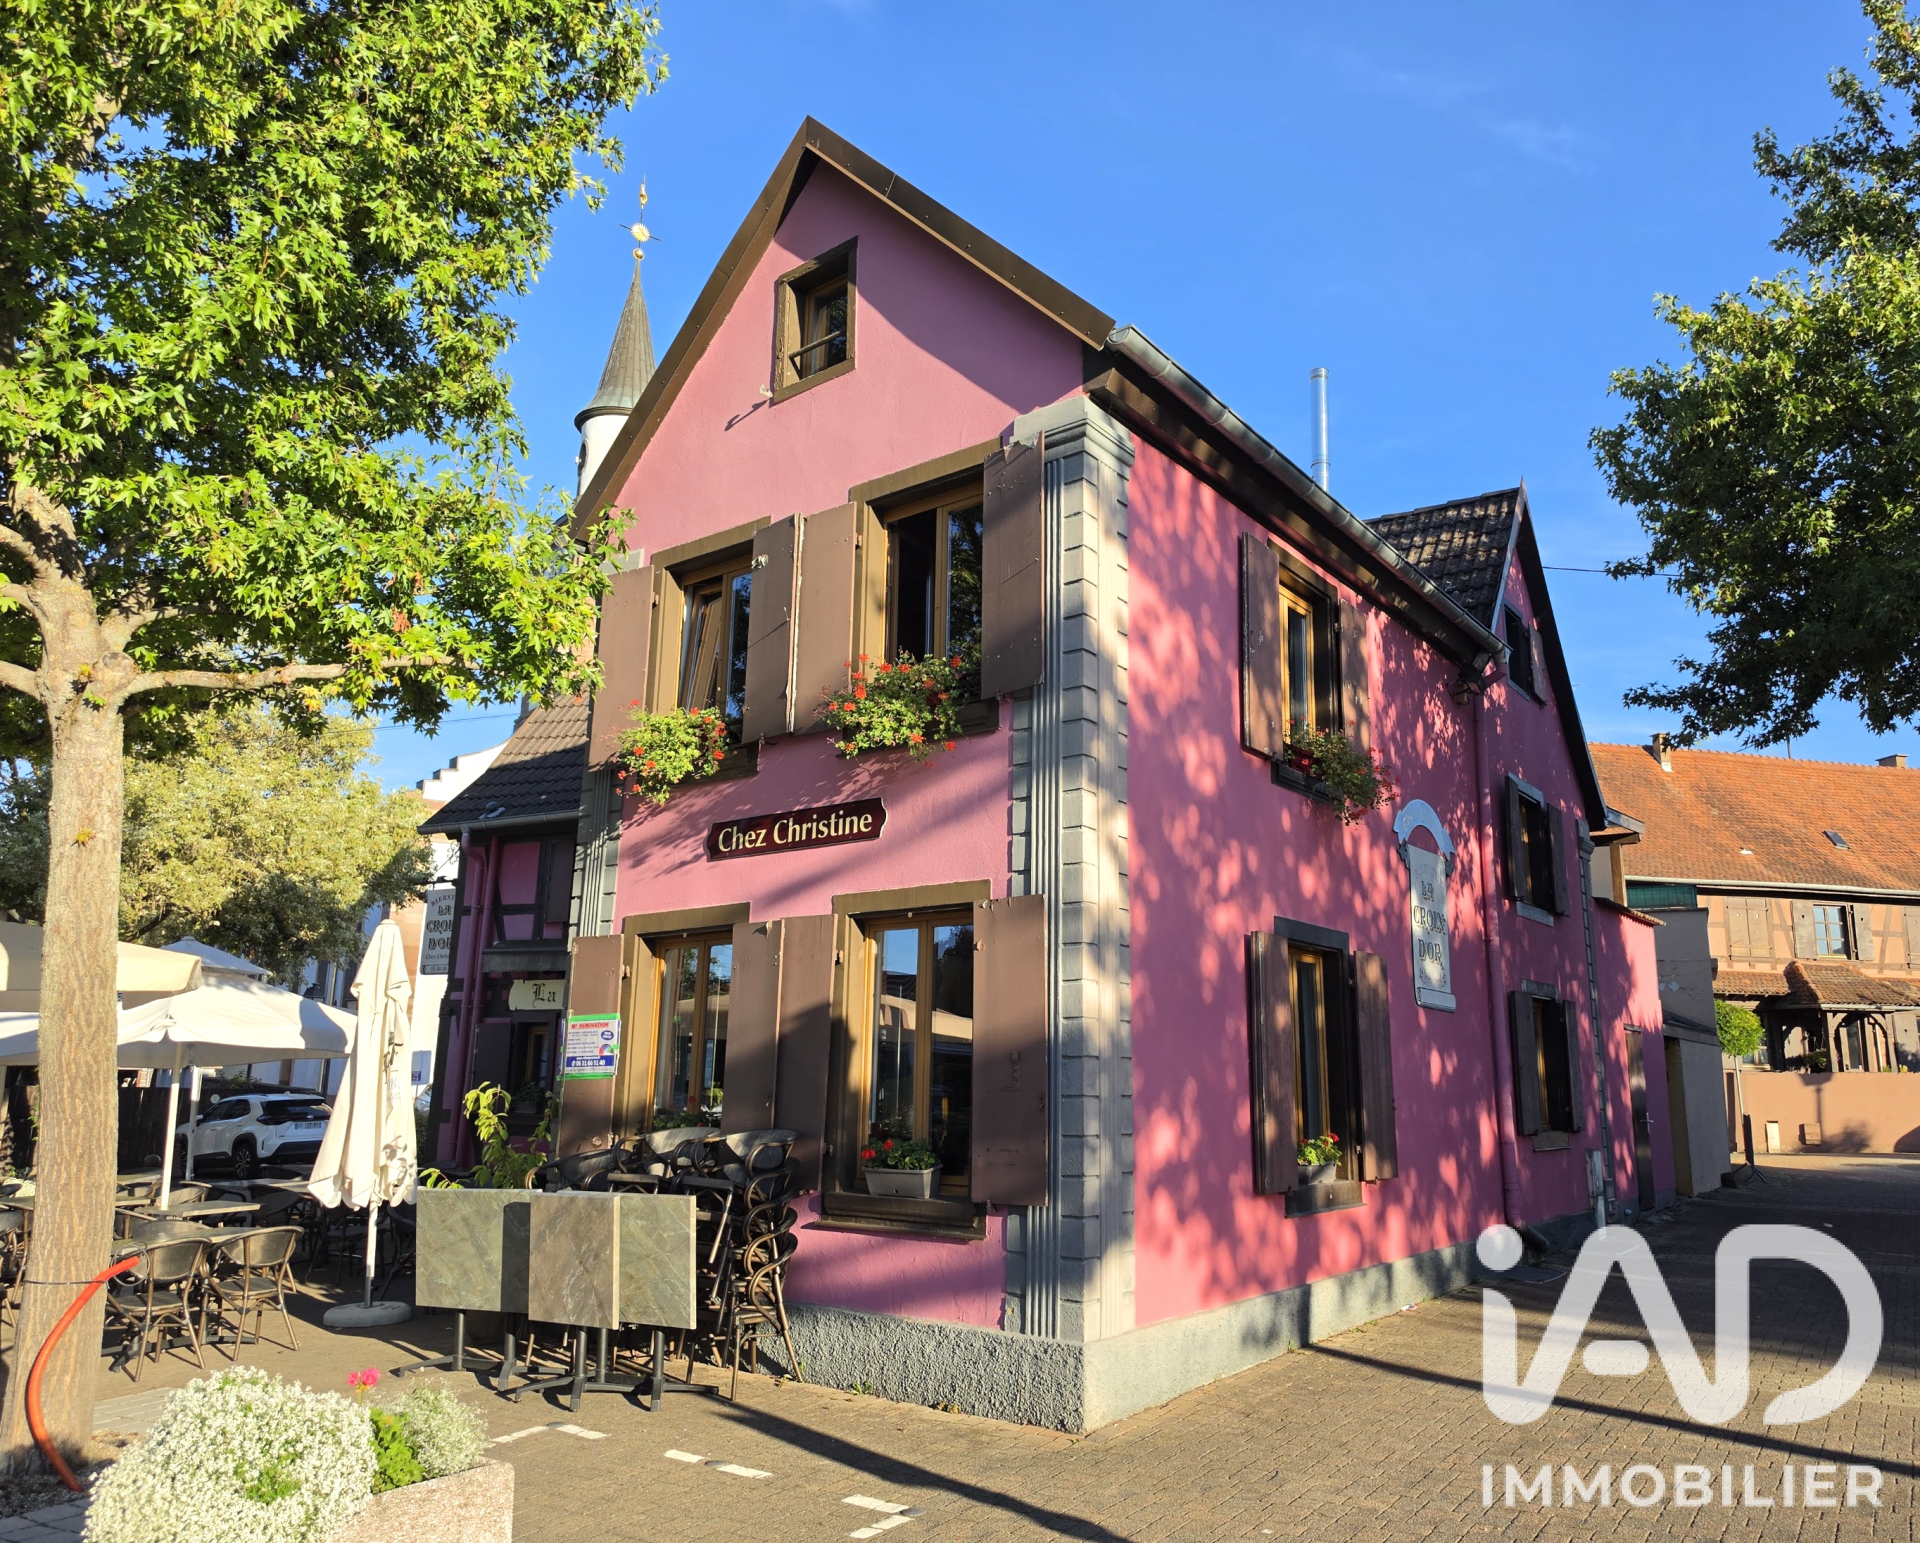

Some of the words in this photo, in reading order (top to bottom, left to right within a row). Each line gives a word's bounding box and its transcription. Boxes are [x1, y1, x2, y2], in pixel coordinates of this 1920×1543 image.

[718, 826, 767, 852] Chez
[773, 810, 873, 844] Christine
[1413, 905, 1447, 935] CROIX
[532, 982, 556, 1008] La
